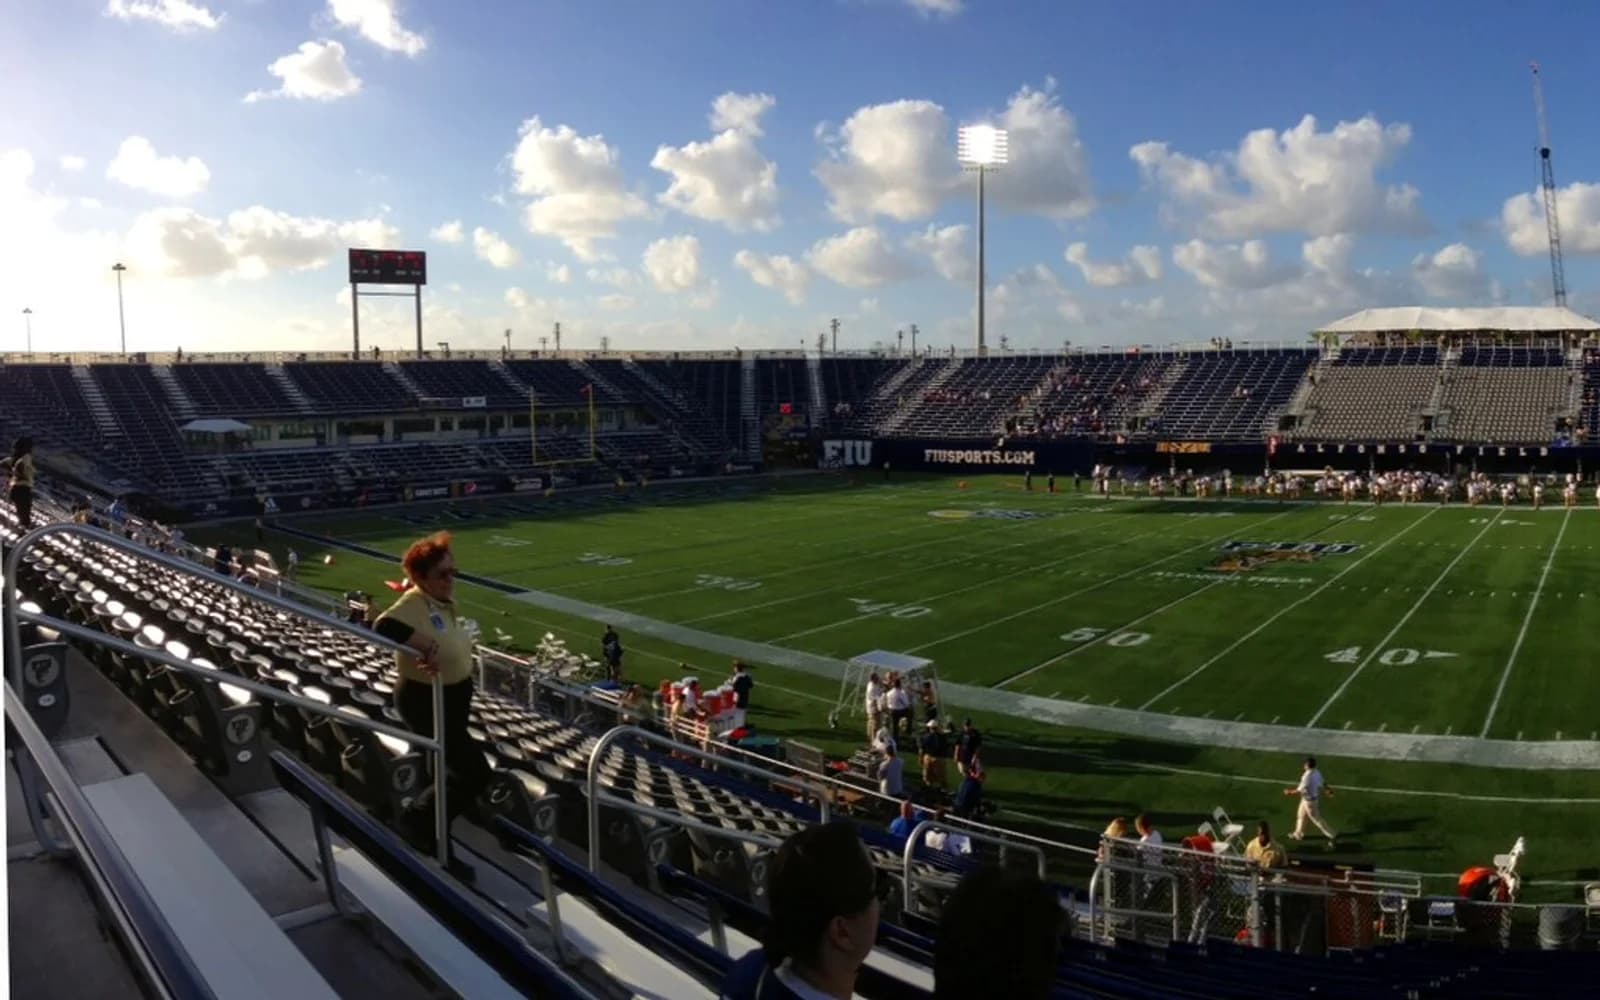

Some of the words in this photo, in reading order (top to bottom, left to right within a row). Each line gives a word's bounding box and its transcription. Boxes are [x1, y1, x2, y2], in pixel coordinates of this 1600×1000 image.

[823, 440, 873, 466] FIU
[923, 448, 1036, 464] FIUSPORTS.COM
[1060, 627, 1152, 647] 50
[1322, 646, 1420, 666] 40
